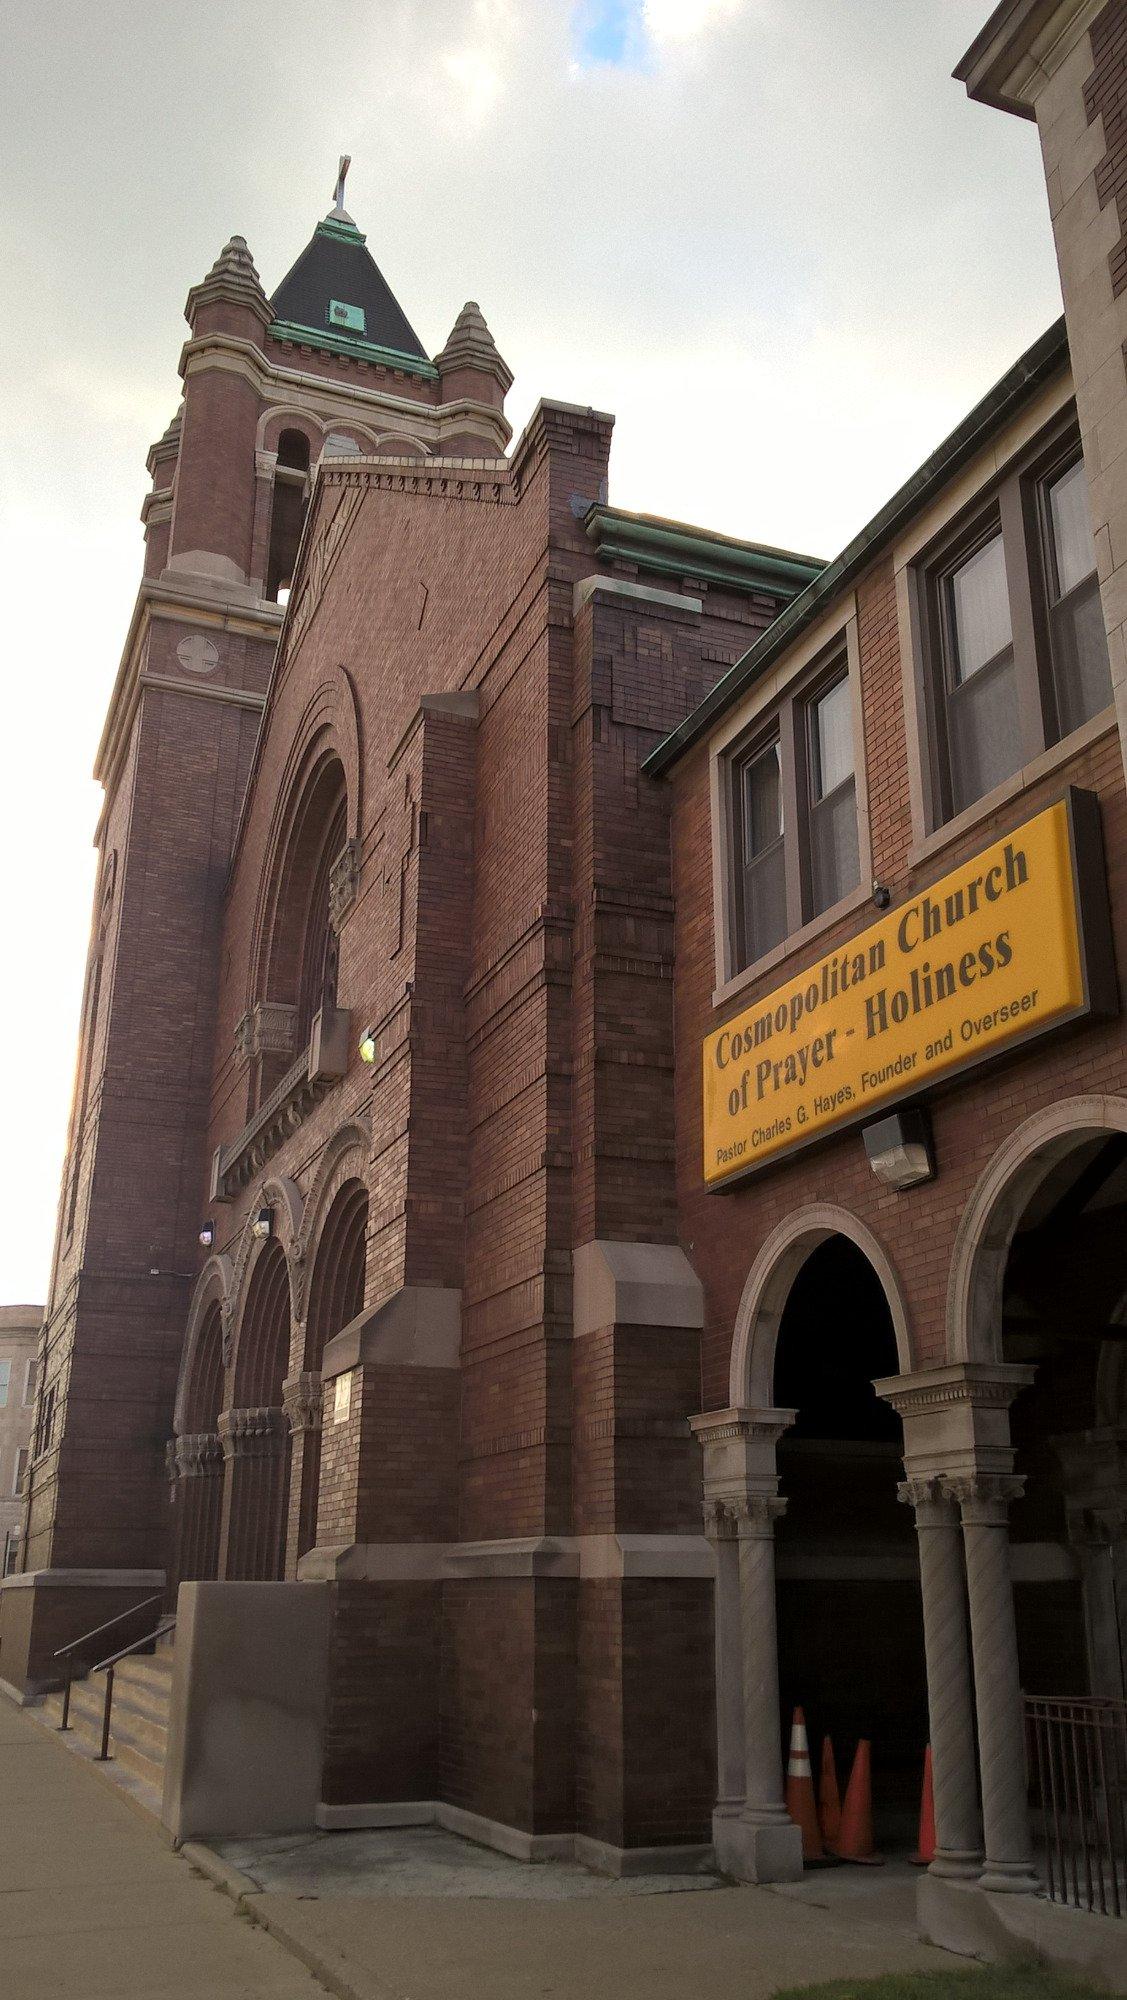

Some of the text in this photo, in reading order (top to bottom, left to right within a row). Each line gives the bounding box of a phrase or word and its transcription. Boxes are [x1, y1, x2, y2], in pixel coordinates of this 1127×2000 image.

[716, 843, 1030, 1069] Cosmopolitan Church
[728, 1069, 750, 1116] of
[756, 1028, 836, 1101] Prayer
[864, 930, 1013, 1040] Holiness
[717, 1139, 747, 1165] Pastor
[751, 1116, 791, 1147] Charles
[797, 1105, 809, 1124] G.
[861, 1050, 917, 1092] Founder
[925, 1029, 953, 1061] and
[961, 988, 1039, 1042] Overseer
